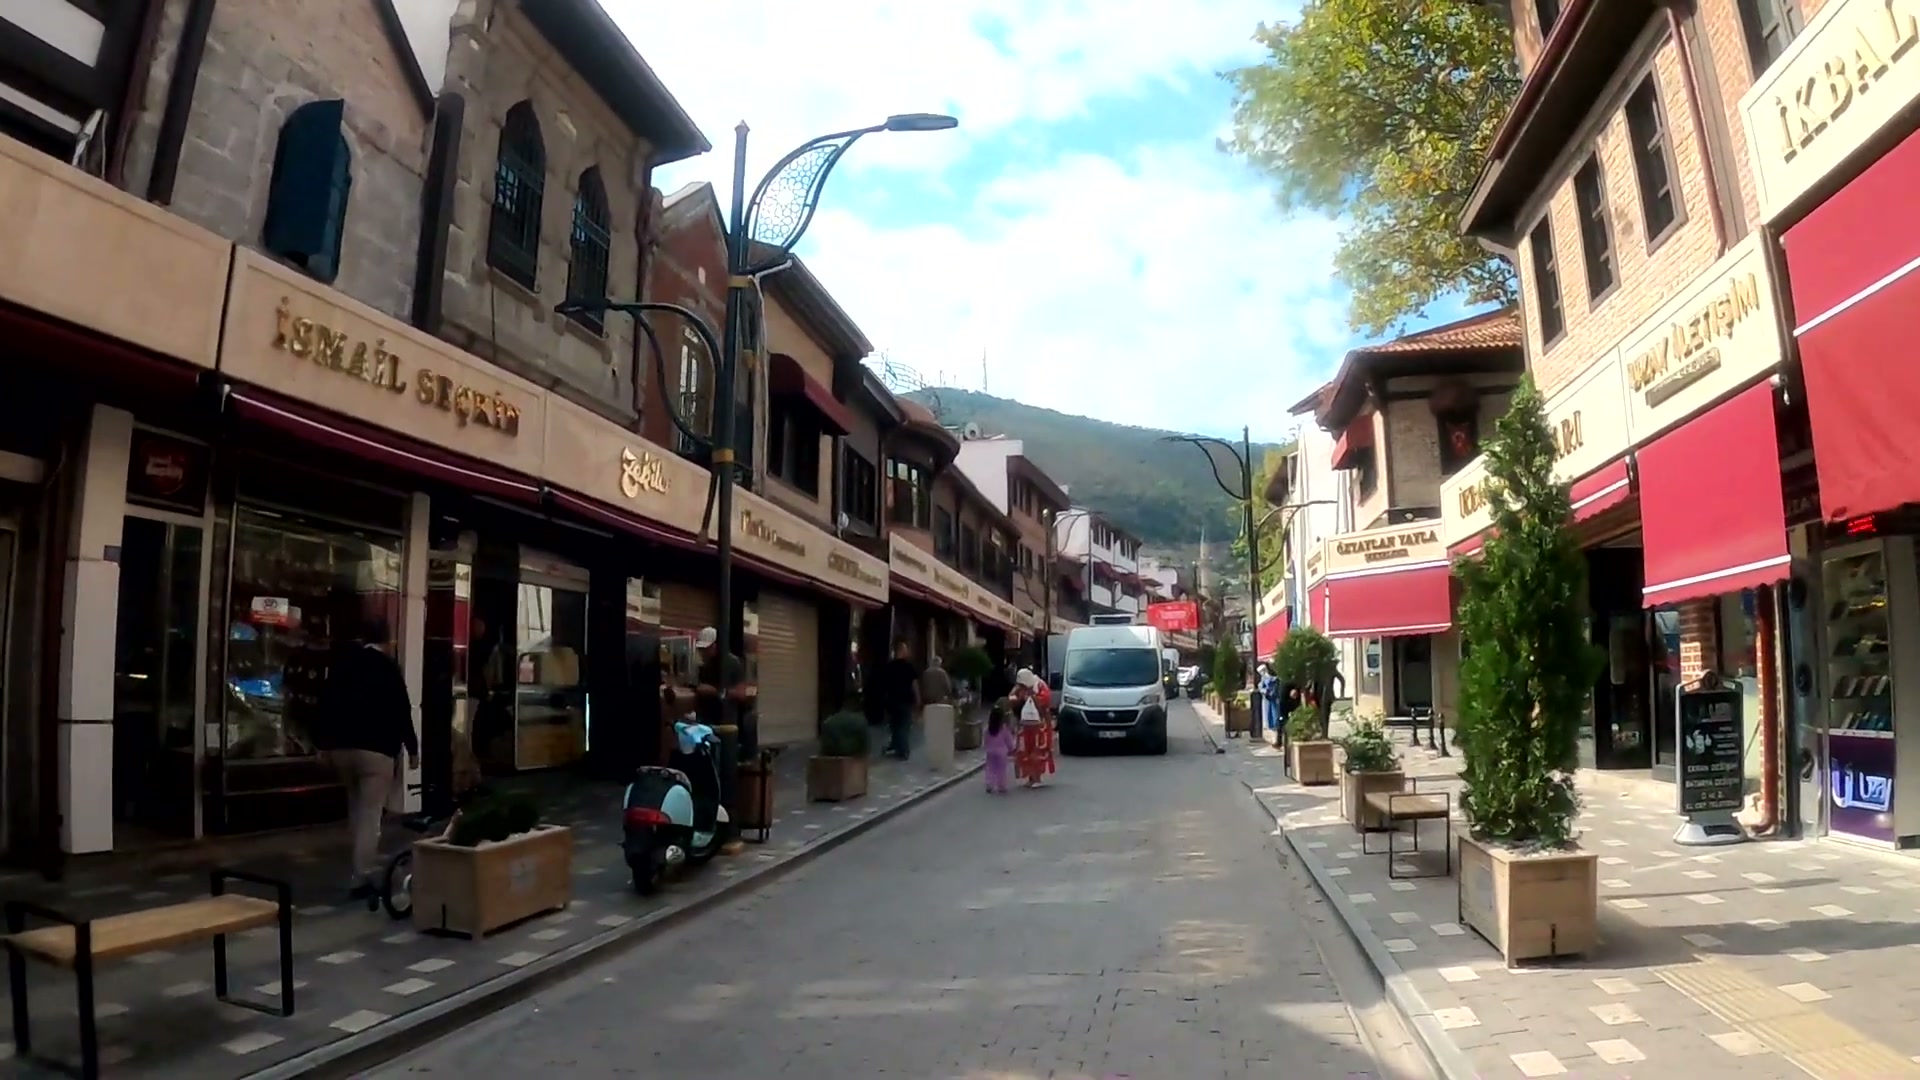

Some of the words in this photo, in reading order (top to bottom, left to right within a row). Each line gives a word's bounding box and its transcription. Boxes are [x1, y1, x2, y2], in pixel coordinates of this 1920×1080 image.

[272, 296, 407, 395] İSMAİL
[416, 368, 520, 437] SEÇKİN
[1397, 530, 1439, 546] YAYLA
